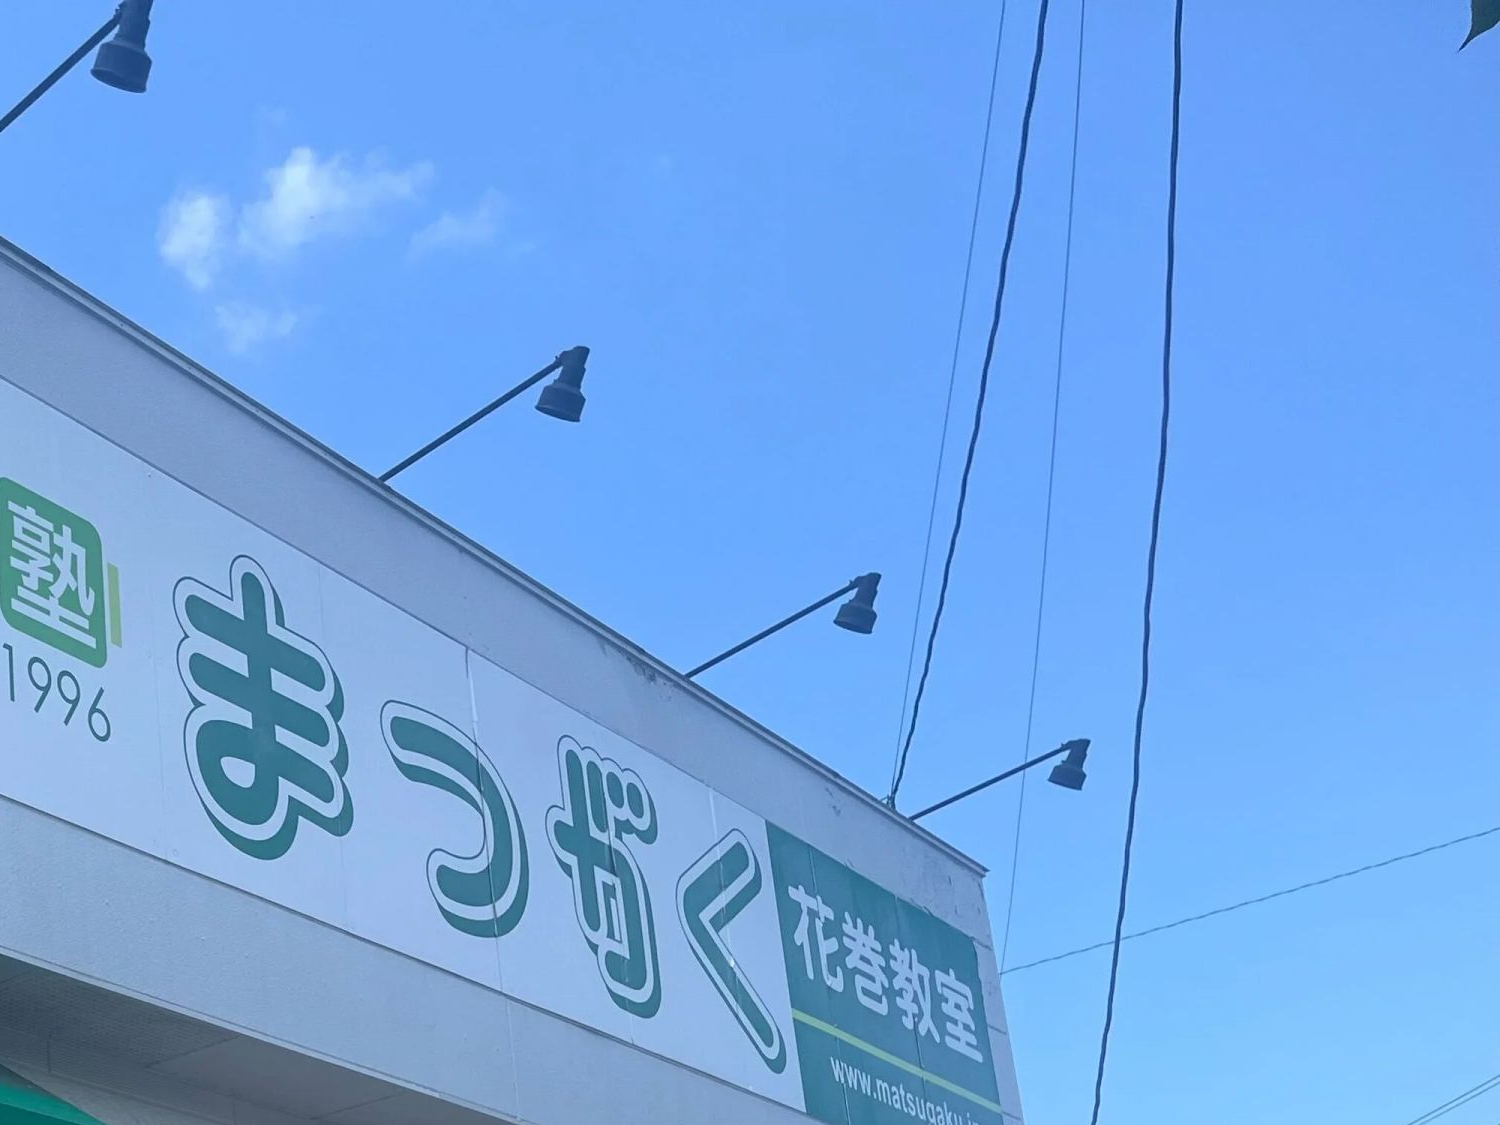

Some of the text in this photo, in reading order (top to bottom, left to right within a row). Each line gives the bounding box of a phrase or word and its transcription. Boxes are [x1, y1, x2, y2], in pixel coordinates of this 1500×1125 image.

[2, 643, 113, 744] 1996
[172, 554, 787, 1074] まつがく
[787, 882, 985, 1064] 花巻教室
